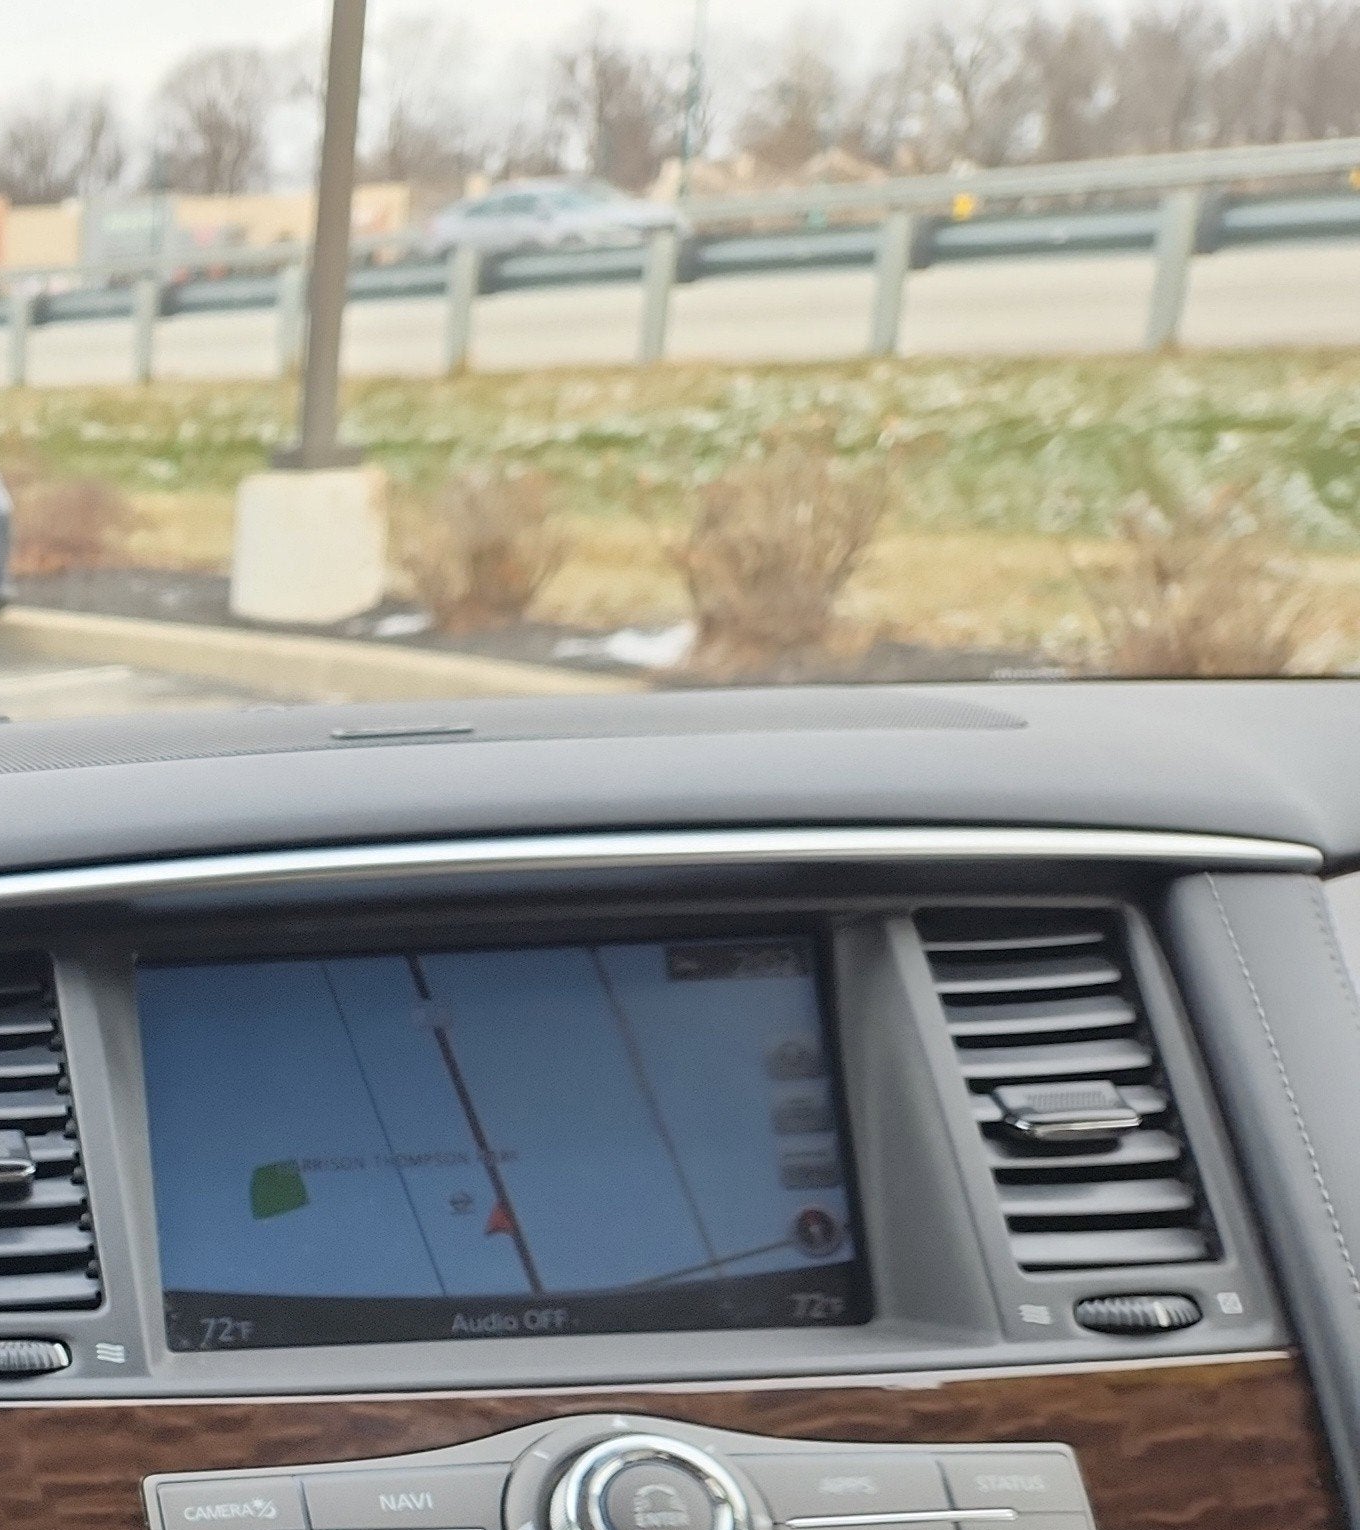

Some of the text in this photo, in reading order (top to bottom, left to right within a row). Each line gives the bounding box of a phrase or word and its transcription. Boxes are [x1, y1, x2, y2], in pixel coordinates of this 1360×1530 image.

[451, 1309, 569, 1334] Audio OFF
[379, 1492, 433, 1511] NAVI
[184, 1505, 254, 1521] CAMERA
